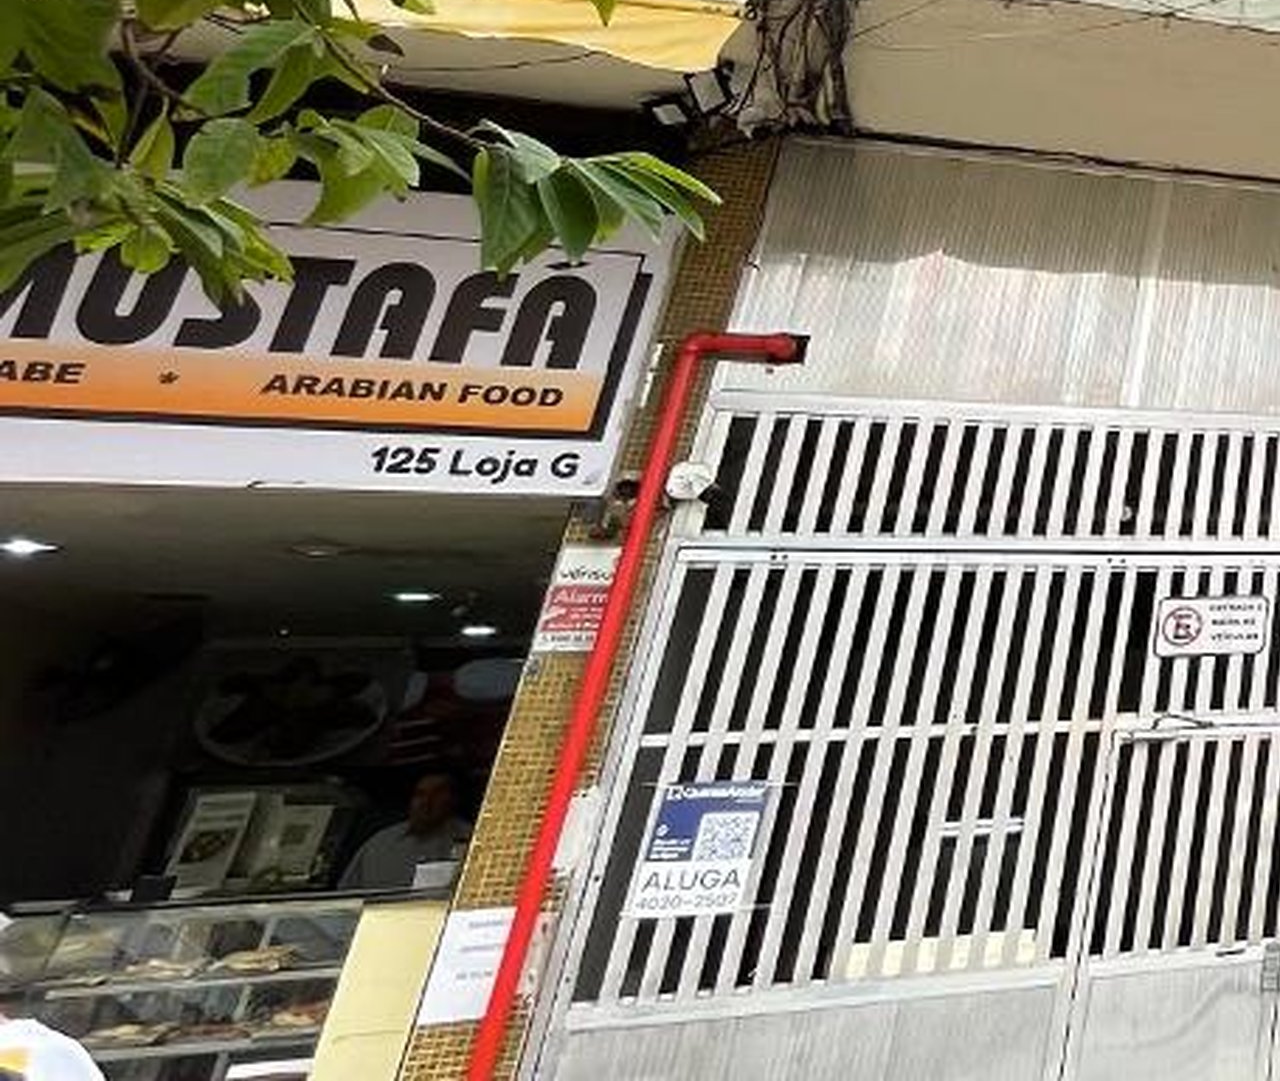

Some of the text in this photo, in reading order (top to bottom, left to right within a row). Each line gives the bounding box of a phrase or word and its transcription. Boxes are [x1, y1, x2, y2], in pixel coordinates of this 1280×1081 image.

[261, 373, 448, 402] ARABIAN
[457, 383, 564, 408] FOOD
[370, 446, 581, 484] 125 Loja G
[641, 868, 741, 893] ALUGA
